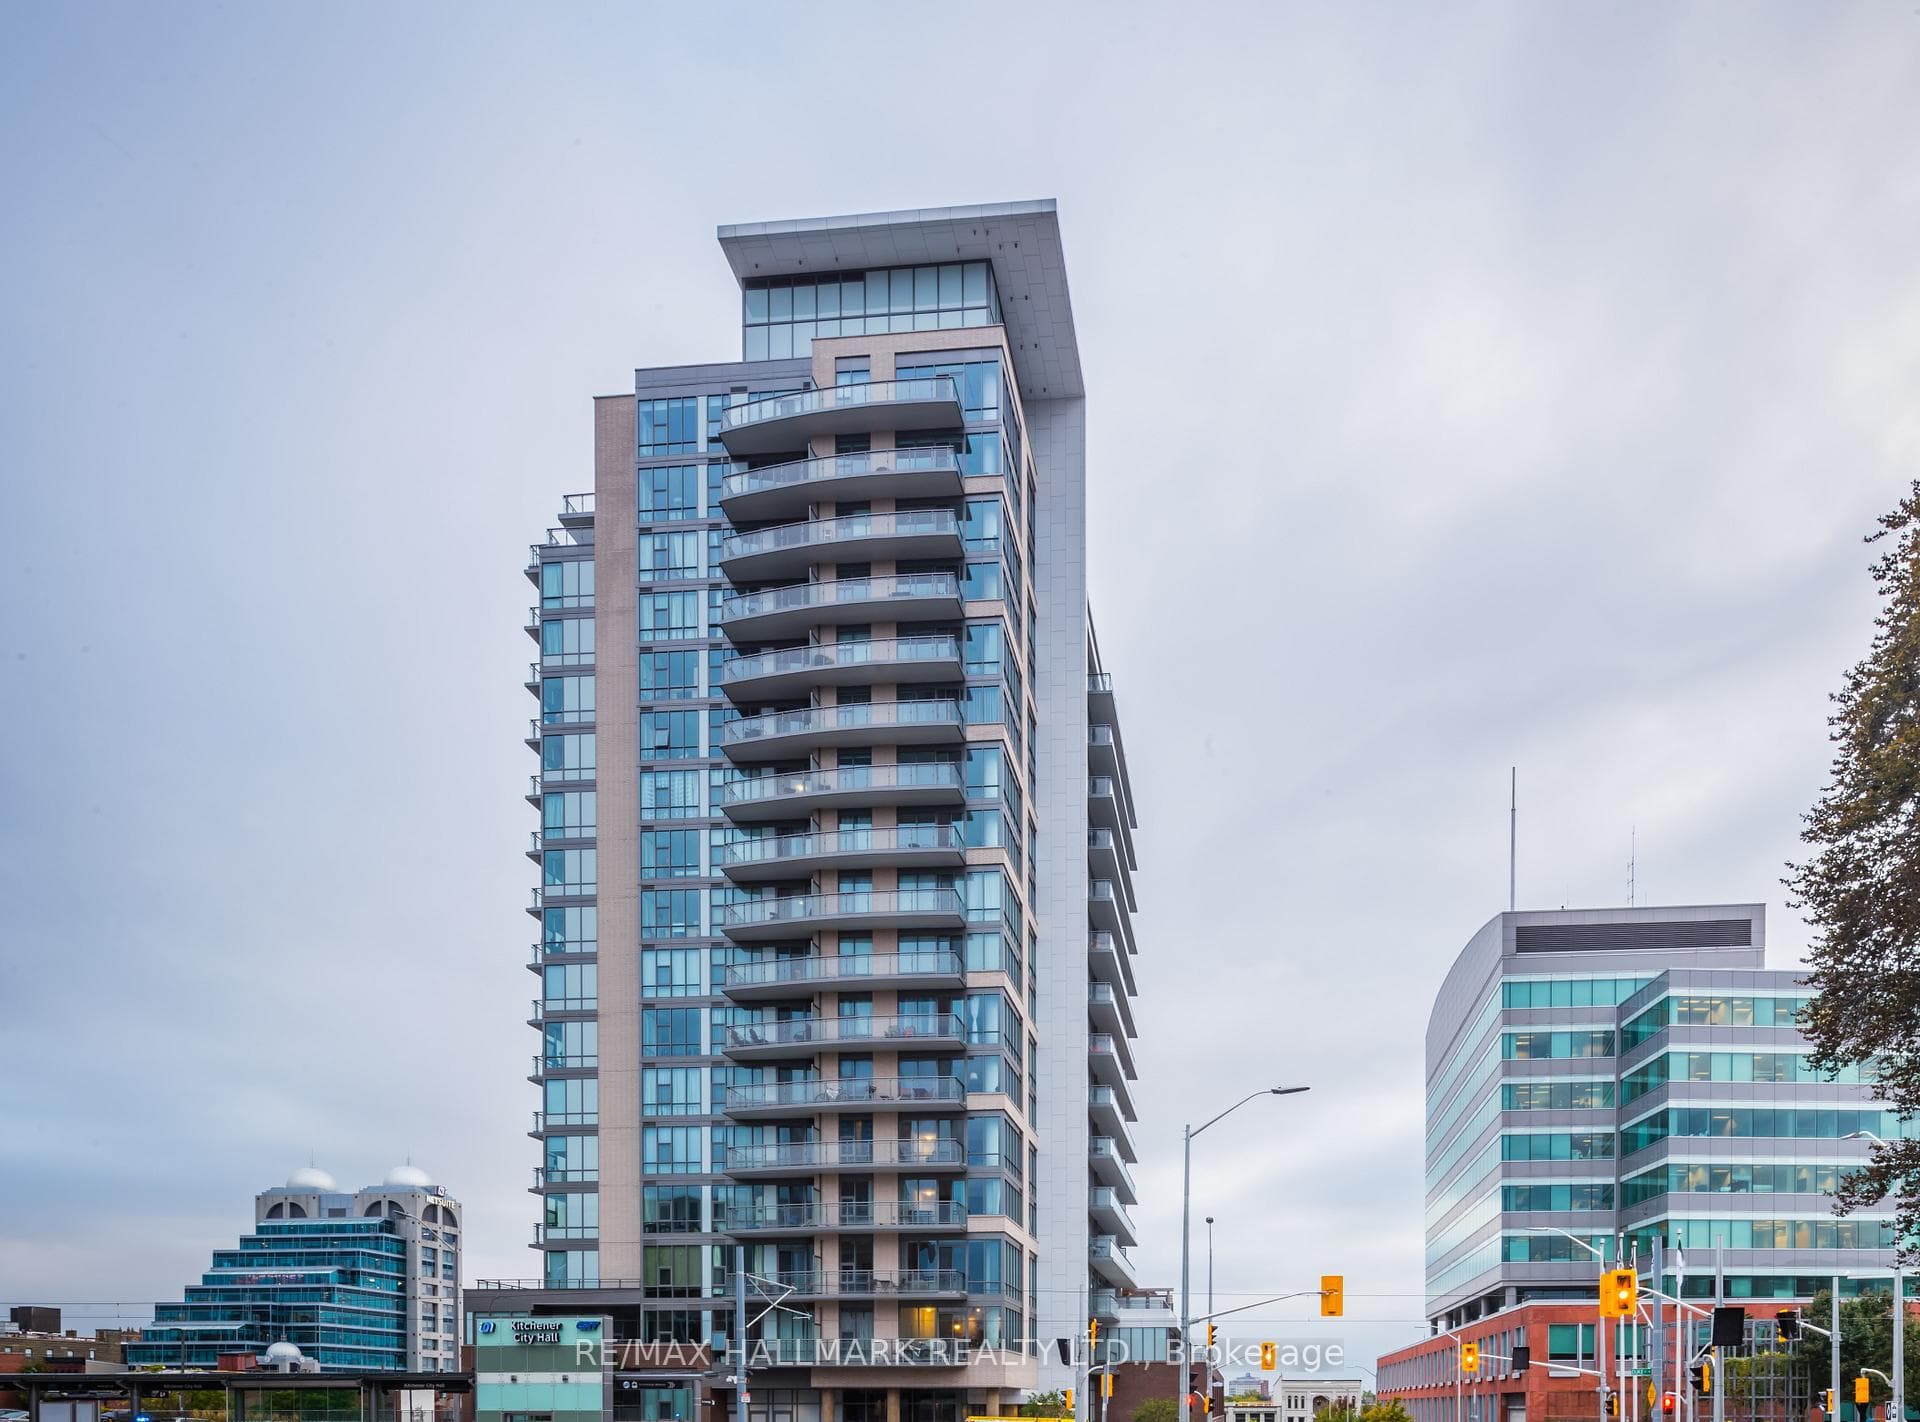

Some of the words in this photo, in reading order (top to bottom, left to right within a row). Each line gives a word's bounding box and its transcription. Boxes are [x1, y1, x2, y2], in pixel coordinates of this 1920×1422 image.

[427, 1194, 455, 1208] NETSUITE
[511, 1320, 562, 1331] Kitchener
[514, 1332, 534, 1344] City
[537, 1332, 560, 1343] Hall
